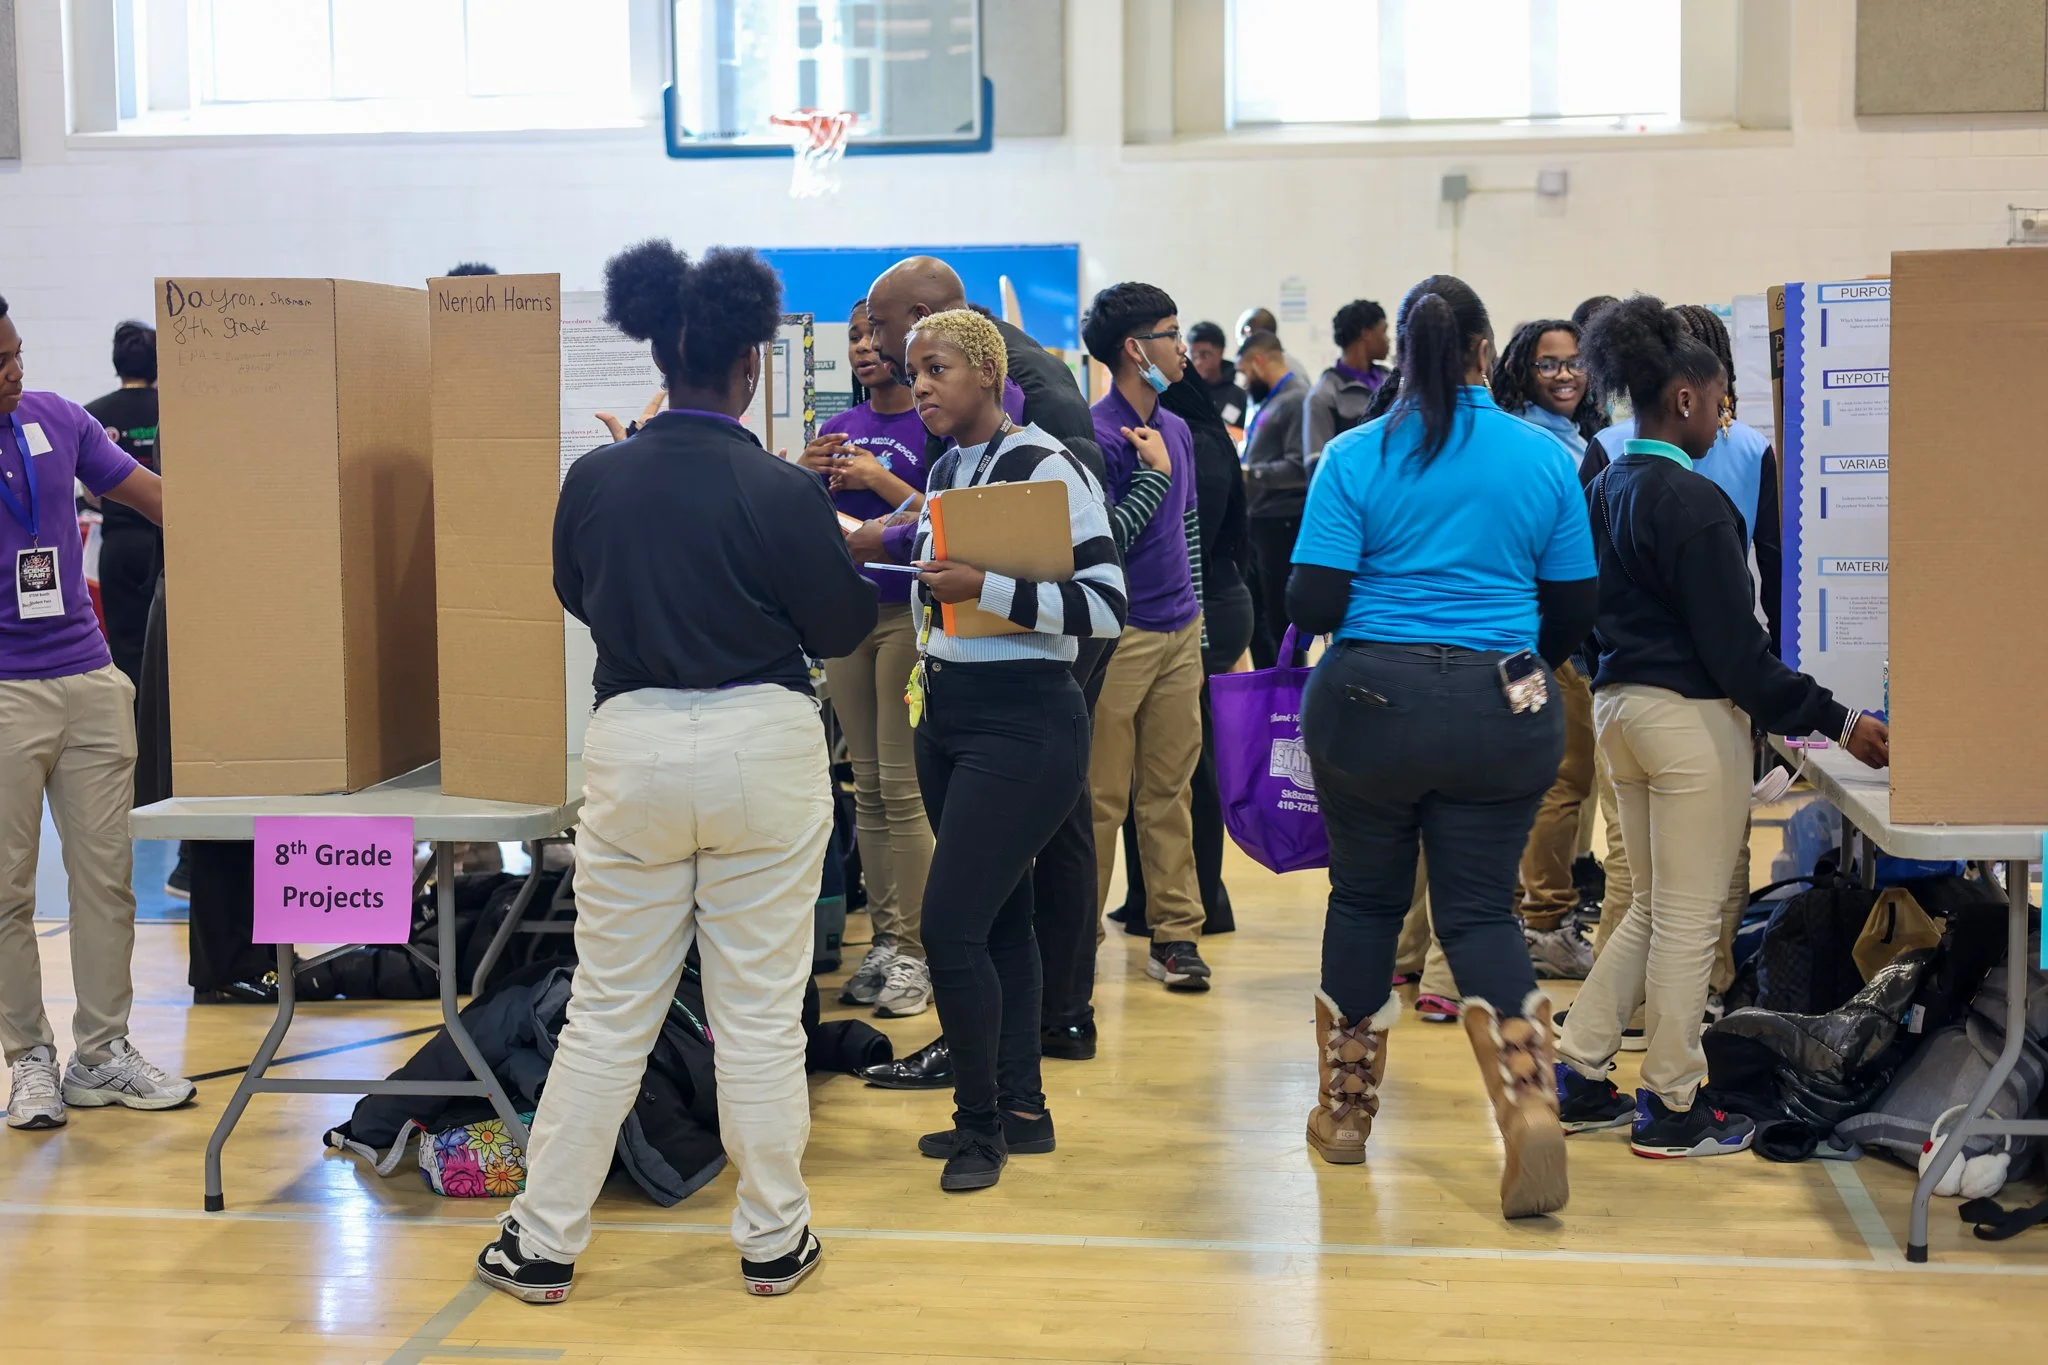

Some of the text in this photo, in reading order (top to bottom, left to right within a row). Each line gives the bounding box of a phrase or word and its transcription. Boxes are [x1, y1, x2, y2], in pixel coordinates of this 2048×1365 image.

[439, 283, 552, 314] Neriah Harris
[173, 316, 213, 345] 8th
[870, 436, 896, 446] MIDDLE
[894, 443, 919, 466] SCHOOL
[275, 840, 392, 866] 8th Grade
[283, 886, 384, 913] Projects
